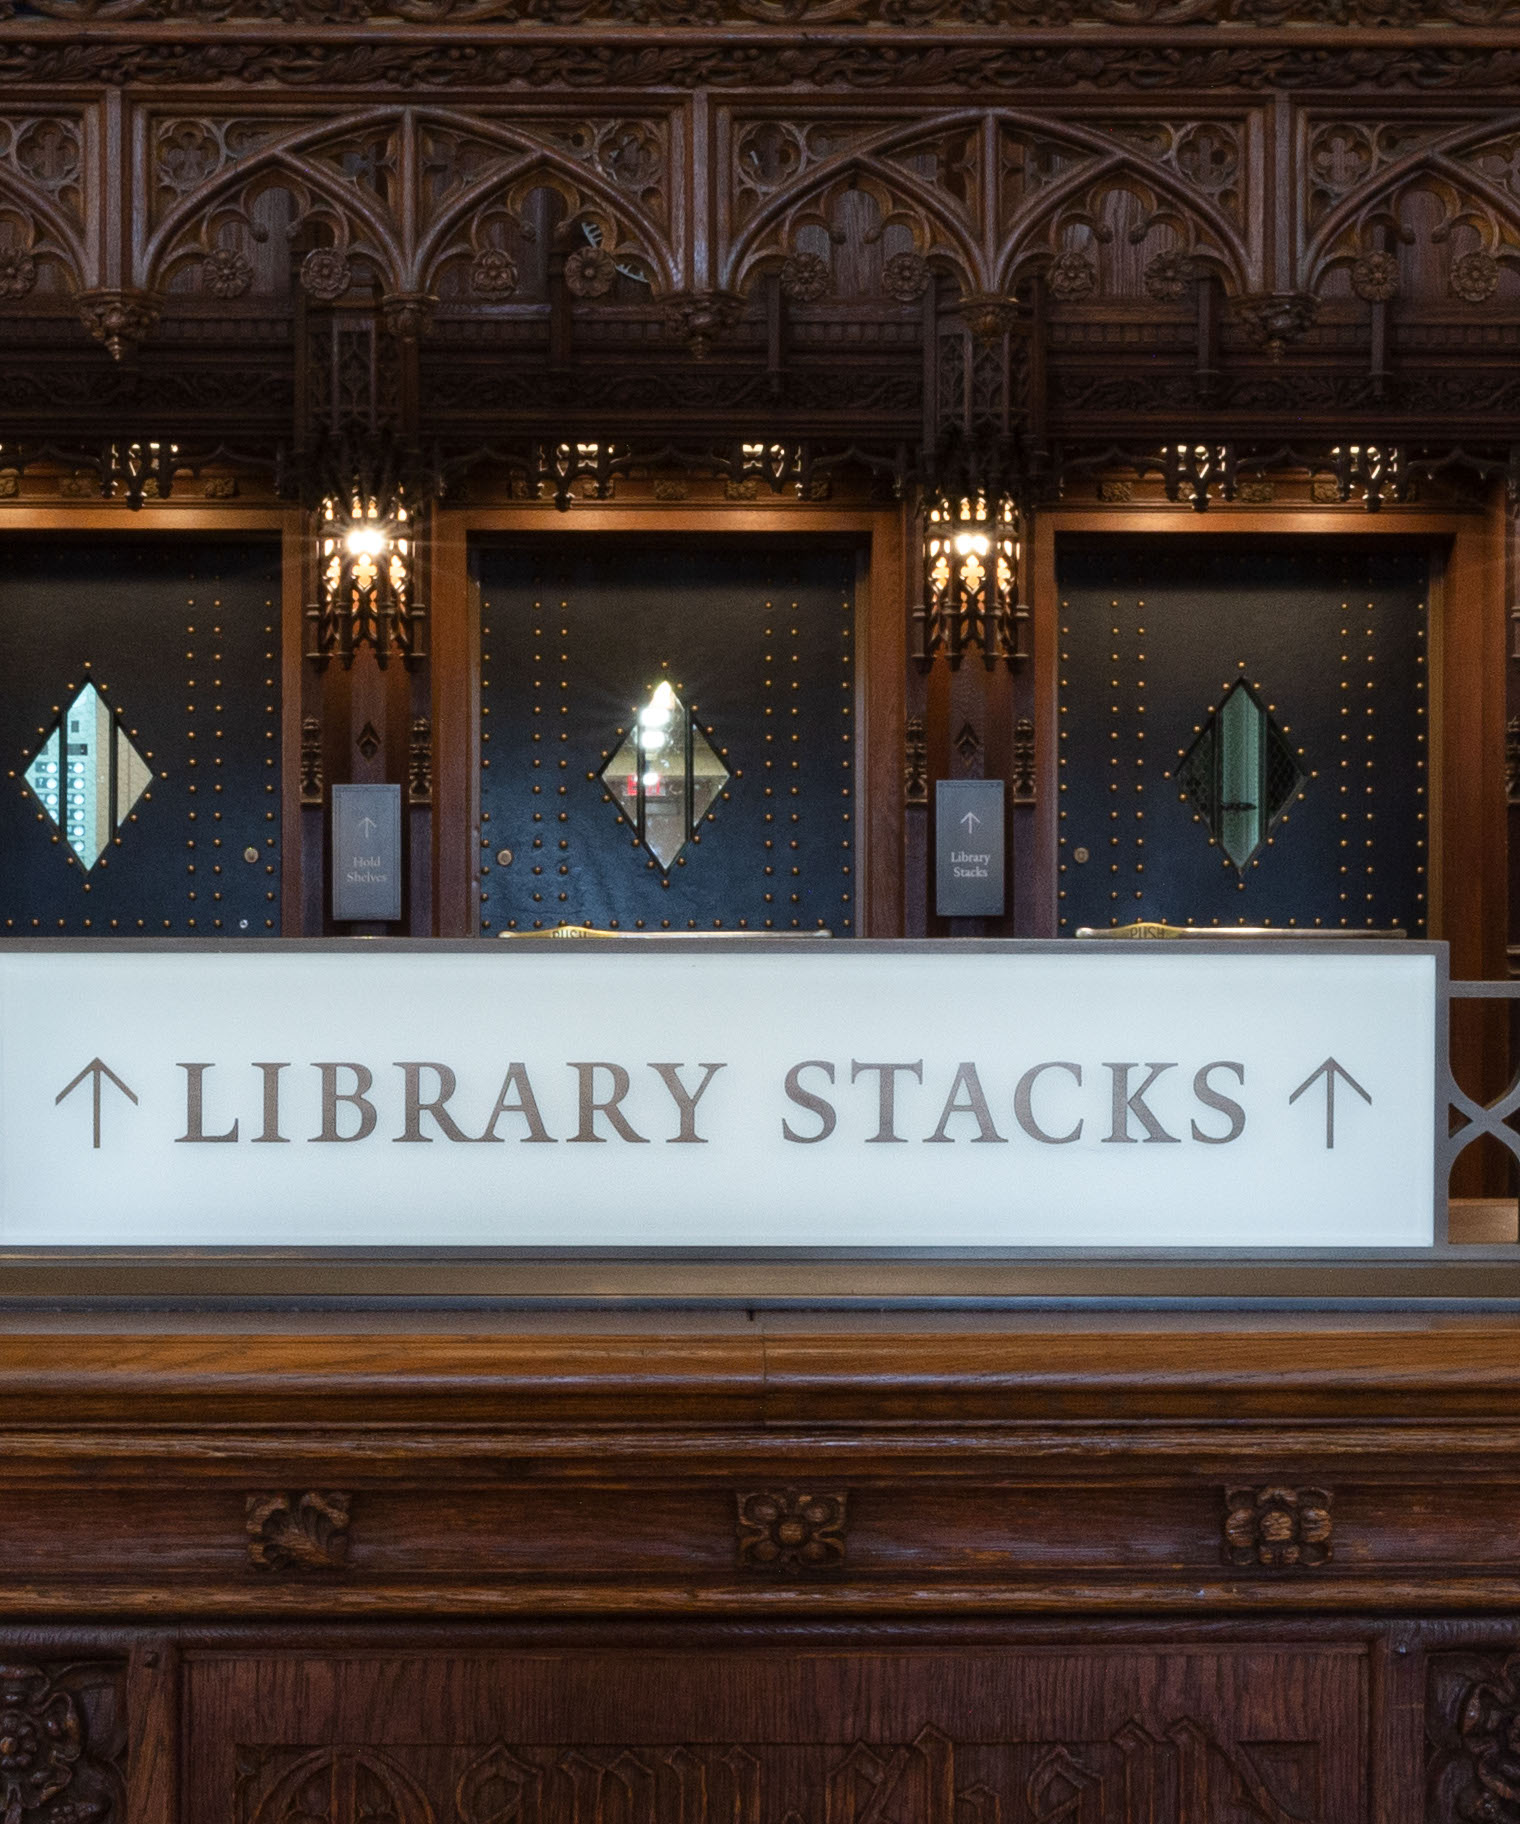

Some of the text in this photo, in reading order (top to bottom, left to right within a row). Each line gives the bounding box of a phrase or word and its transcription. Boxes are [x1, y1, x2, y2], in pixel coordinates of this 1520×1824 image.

[353, 856, 380, 867] Hold
[951, 851, 990, 866] Library
[346, 871, 387, 882] Shelves
[953, 866, 989, 877] Stacks
[175, 1059, 1247, 1145] LIBRARY STACKS
